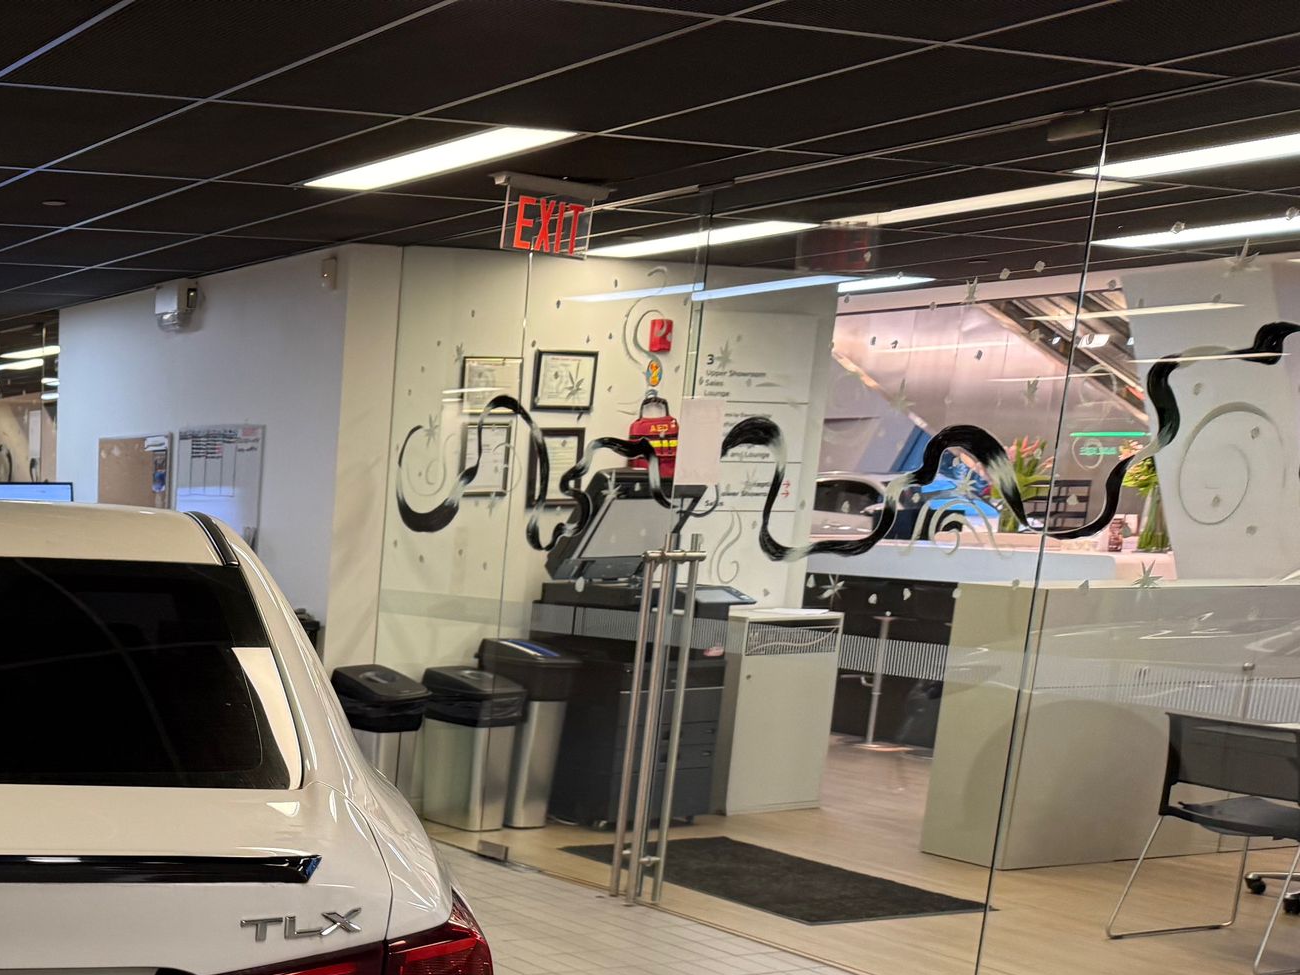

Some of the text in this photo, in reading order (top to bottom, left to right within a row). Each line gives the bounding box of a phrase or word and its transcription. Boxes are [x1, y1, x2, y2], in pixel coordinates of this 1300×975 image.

[513, 195, 586, 256] EXIT
[706, 353, 715, 365] 3
[706, 369, 728, 378] Upper
[650, 424, 669, 433] AED
[240, 907, 362, 942] TLX
